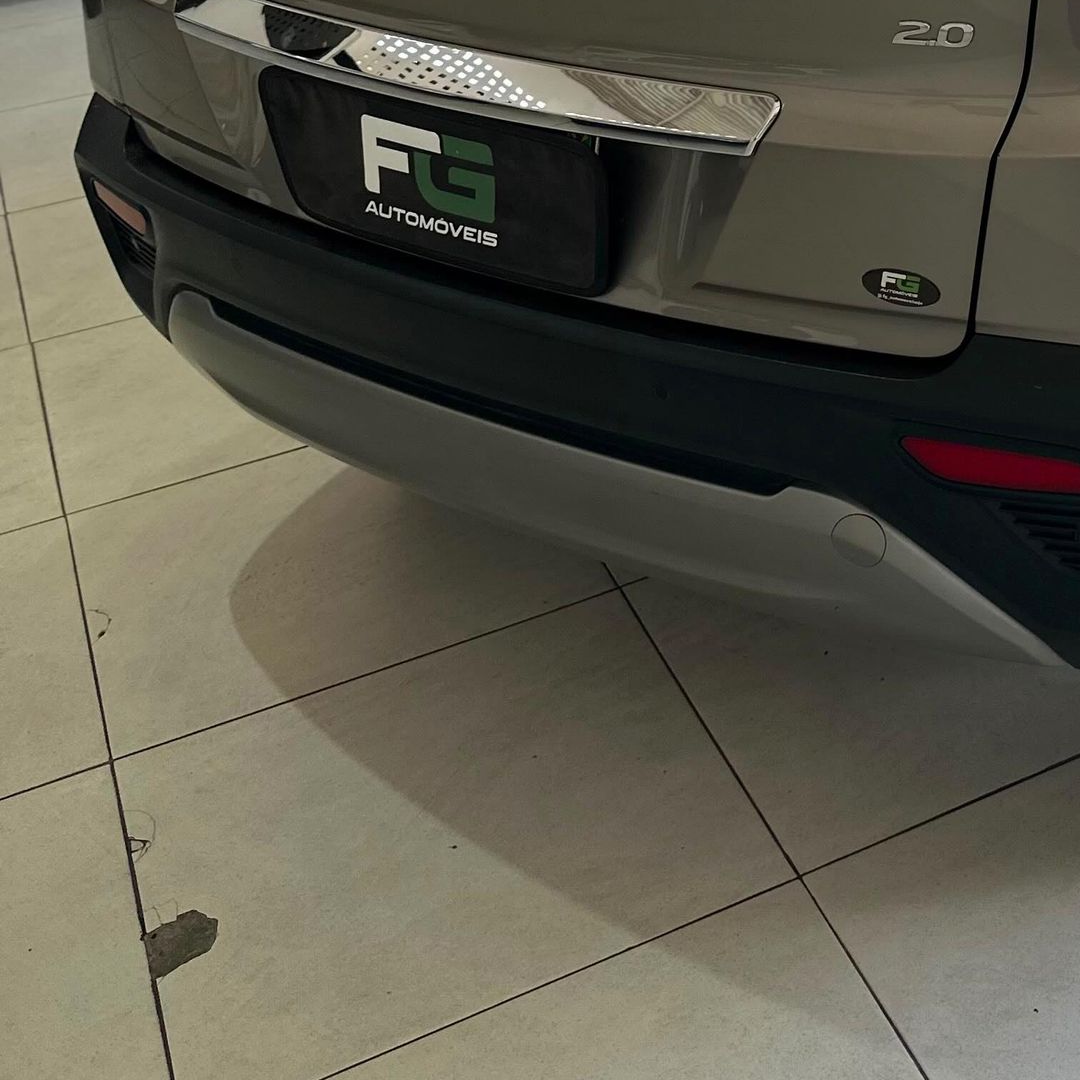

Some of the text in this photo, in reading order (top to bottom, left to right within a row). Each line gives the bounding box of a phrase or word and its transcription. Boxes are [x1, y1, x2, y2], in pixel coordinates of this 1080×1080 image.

[361, 114, 496, 224] FG
[365, 200, 498, 247] AUTOMÓVEIS
[880, 271, 921, 293] FG
